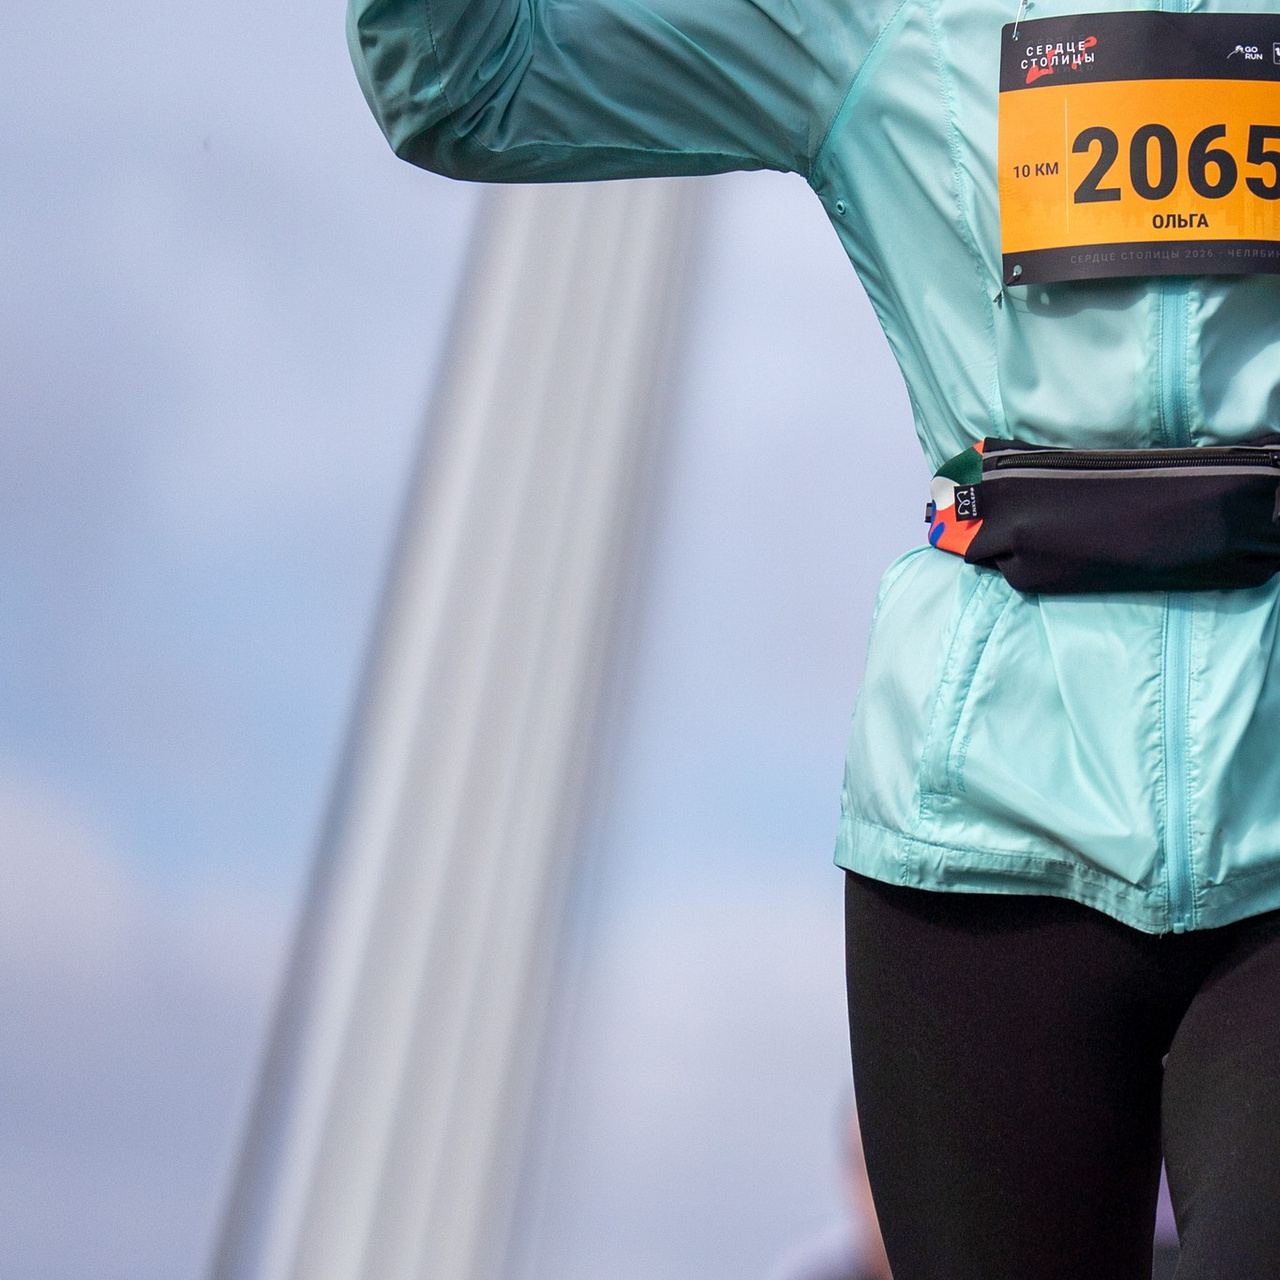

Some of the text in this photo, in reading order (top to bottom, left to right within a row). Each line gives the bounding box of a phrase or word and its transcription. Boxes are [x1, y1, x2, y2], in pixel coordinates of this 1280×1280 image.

[1026, 41, 1086, 56] СЕРДЦЕ
[1021, 52, 1095, 69] СТОЛИЦЫ
[1013, 164, 1031, 178] 10
[1152, 214, 1209, 229] ОЛЬГА
[1070, 252, 1116, 264] СЕРДЦЕ
[1121, 250, 1180, 260] СТОЛИЦЫ
[1185, 249, 1214, 258] 2026
[955, 735, 971, 793] packable
